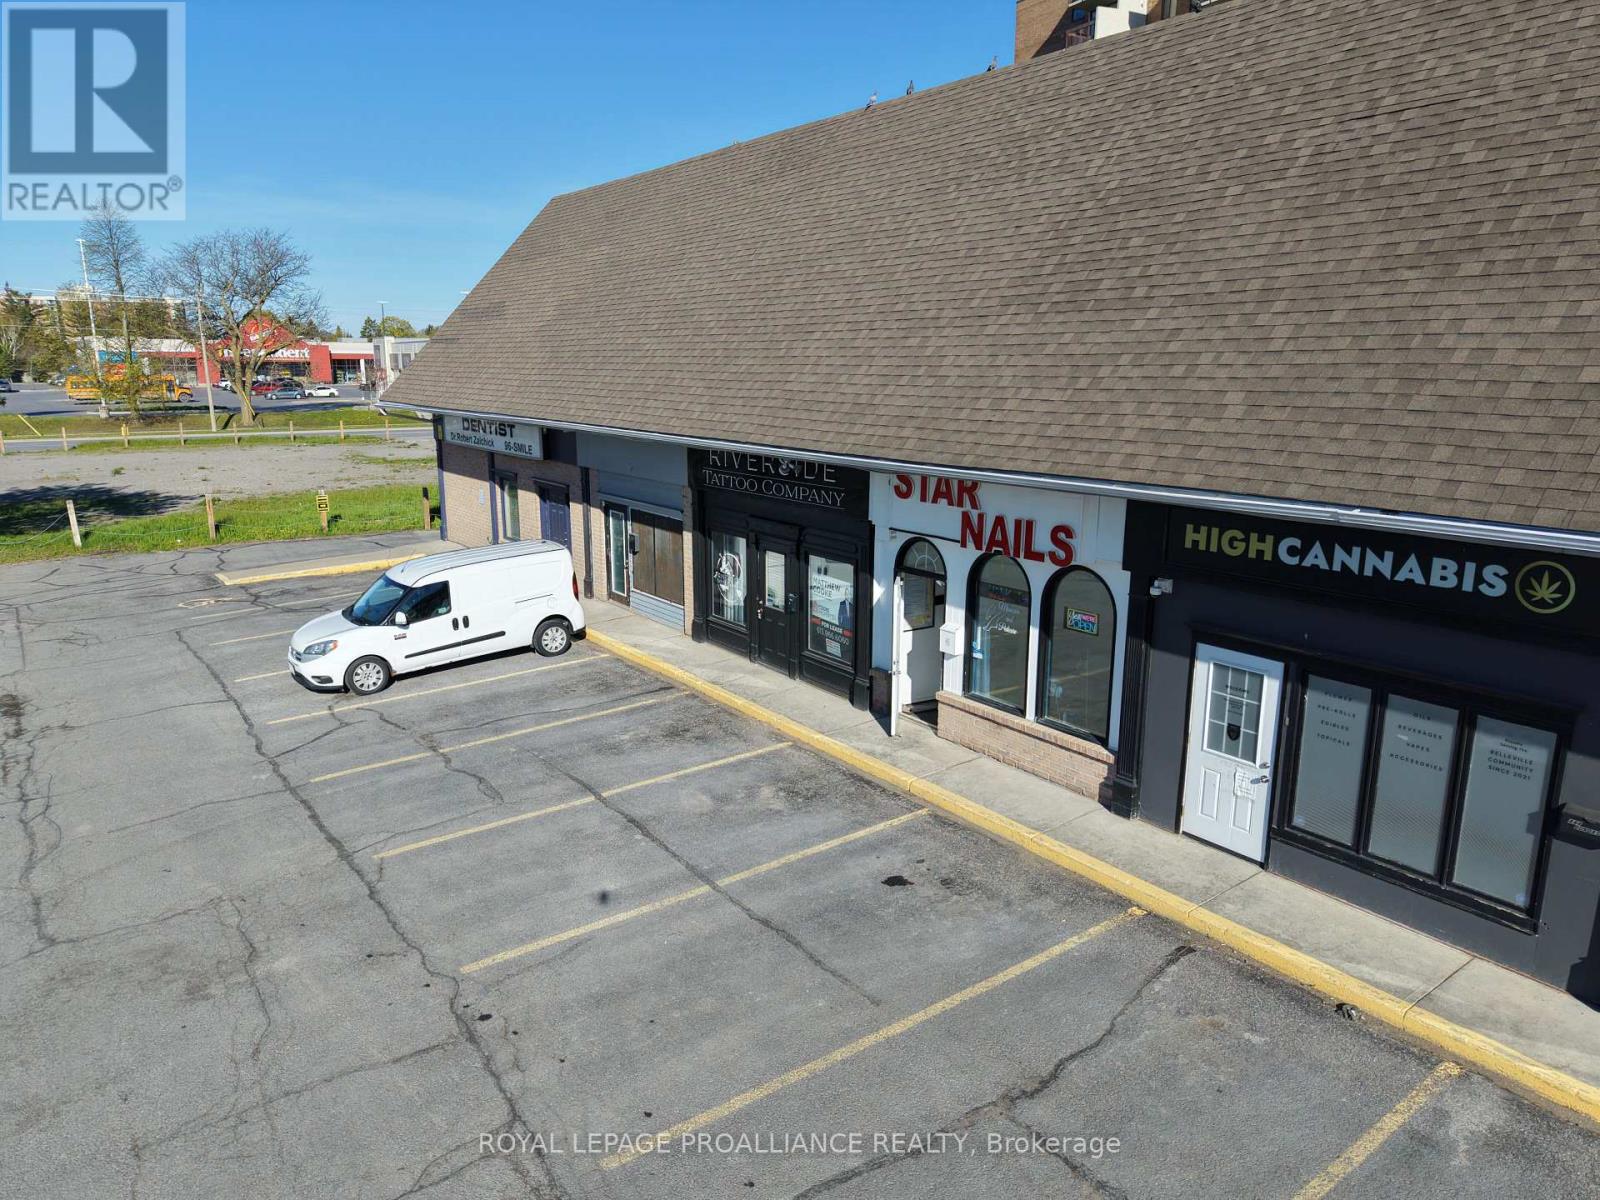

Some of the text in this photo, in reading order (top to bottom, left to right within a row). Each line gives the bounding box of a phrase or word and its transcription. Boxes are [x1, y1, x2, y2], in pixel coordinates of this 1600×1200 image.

[462, 417, 515, 438] DENTIST
[703, 469, 846, 507] TATTOO COMPANY
[893, 474, 981, 510] STAR
[960, 510, 1076, 568] NAILS
[1488, 757, 1533, 773] COMMUNITY
[1490, 750, 1533, 765] BELLEVILLE
